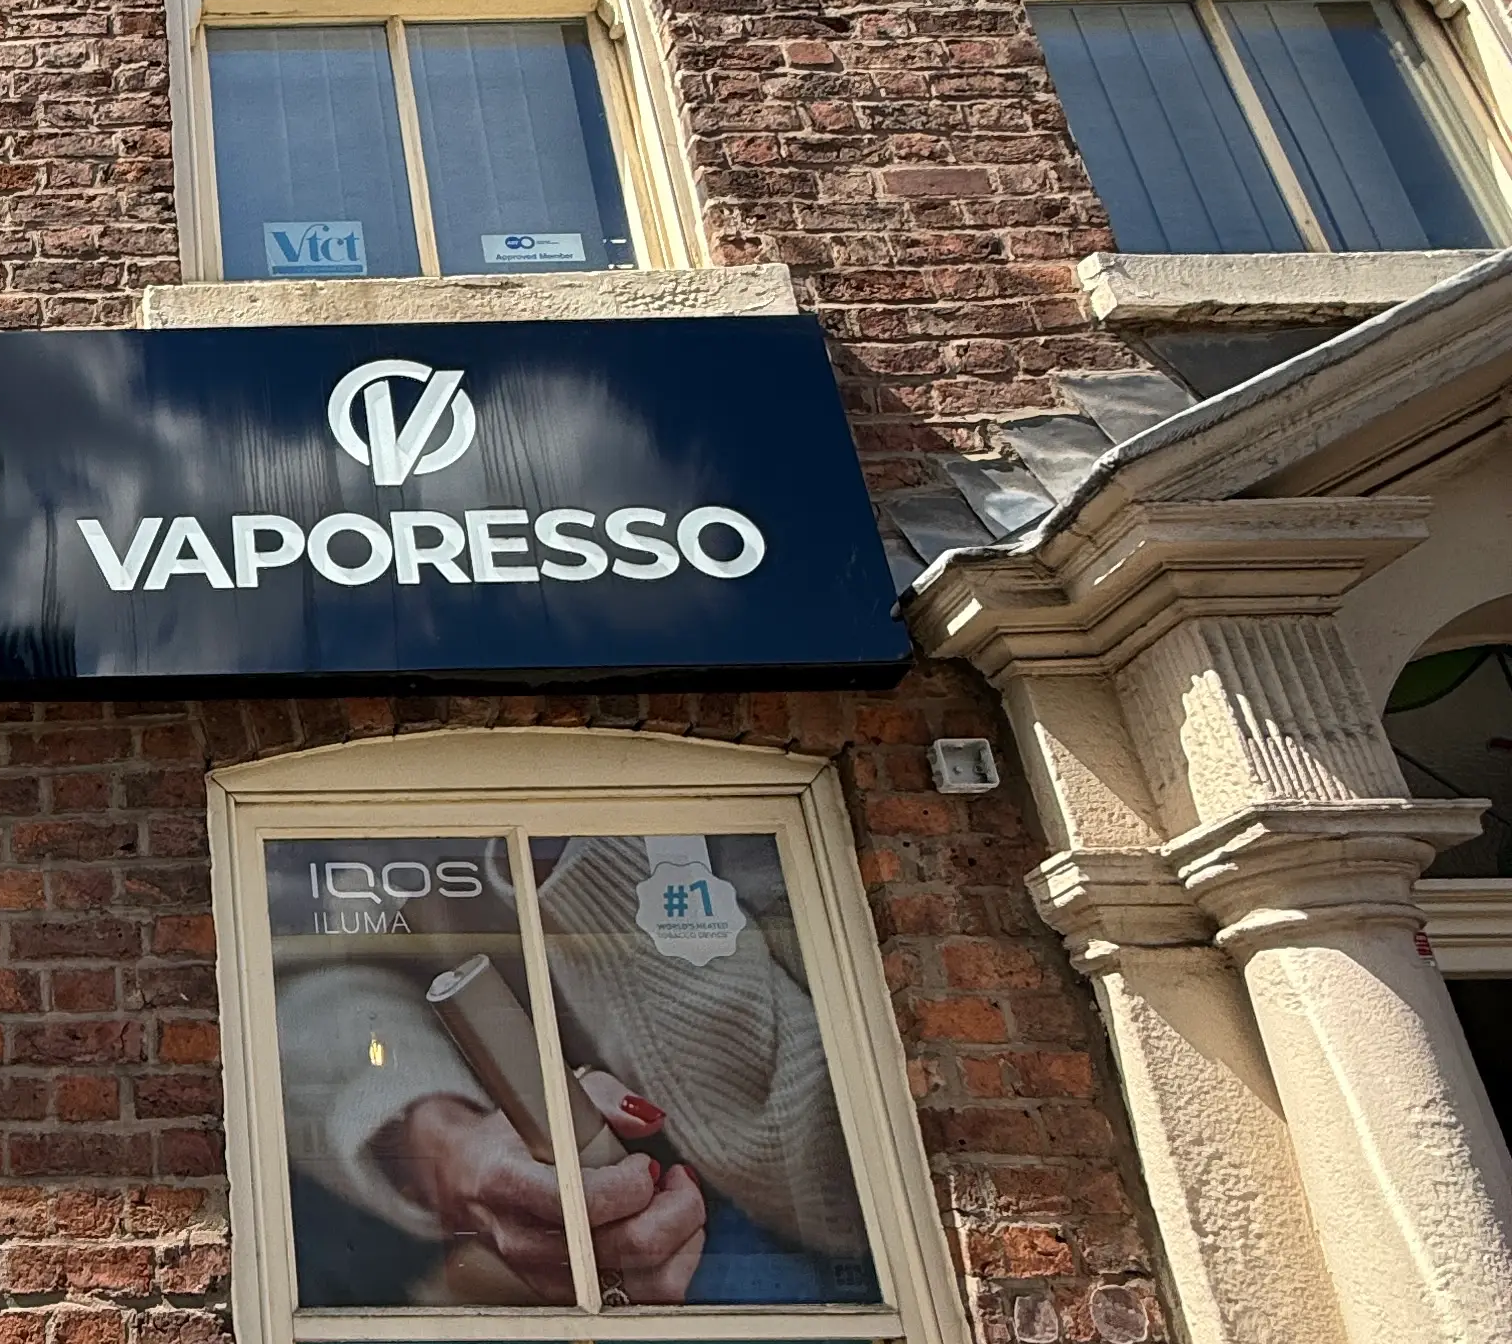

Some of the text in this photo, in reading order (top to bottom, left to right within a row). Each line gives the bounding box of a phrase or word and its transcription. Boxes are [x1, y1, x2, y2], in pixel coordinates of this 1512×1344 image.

[496, 253, 536, 261] Approved
[76, 505, 766, 591] VAPORESSO
[310, 861, 483, 904] IQOS
[663, 879, 714, 917] #1
[313, 910, 412, 934] ILUMA
